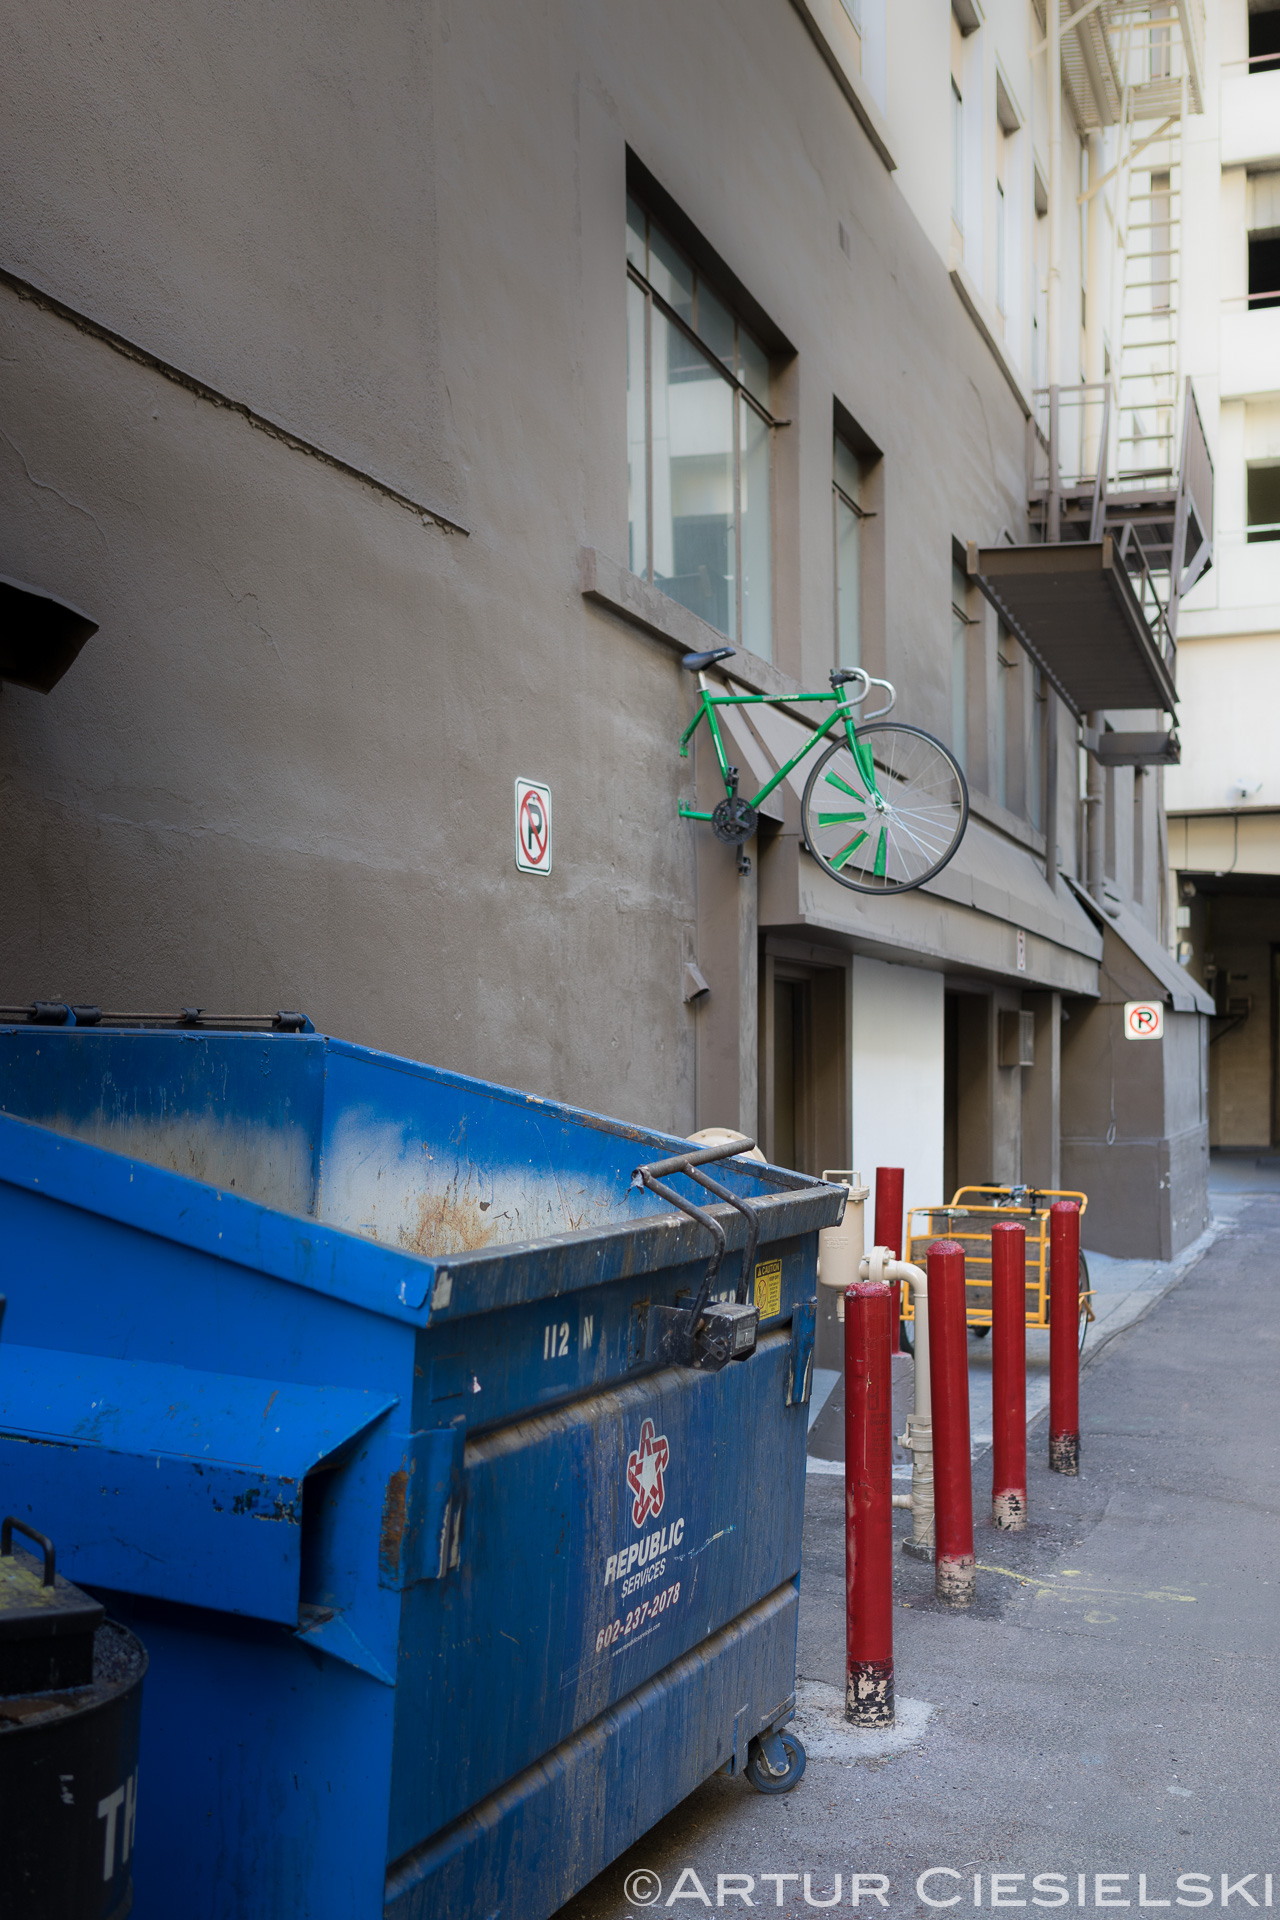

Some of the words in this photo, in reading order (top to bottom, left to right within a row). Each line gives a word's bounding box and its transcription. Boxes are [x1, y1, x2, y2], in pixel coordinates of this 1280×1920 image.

[762, 1263, 780, 1275] CAUTION
[543, 1322, 570, 1361] 112
[582, 1314, 594, 1351] N
[603, 1517, 685, 1587] REPUBLIC
[621, 1557, 666, 1599] SERVICES
[595, 1581, 681, 1654] 602-237-2078
